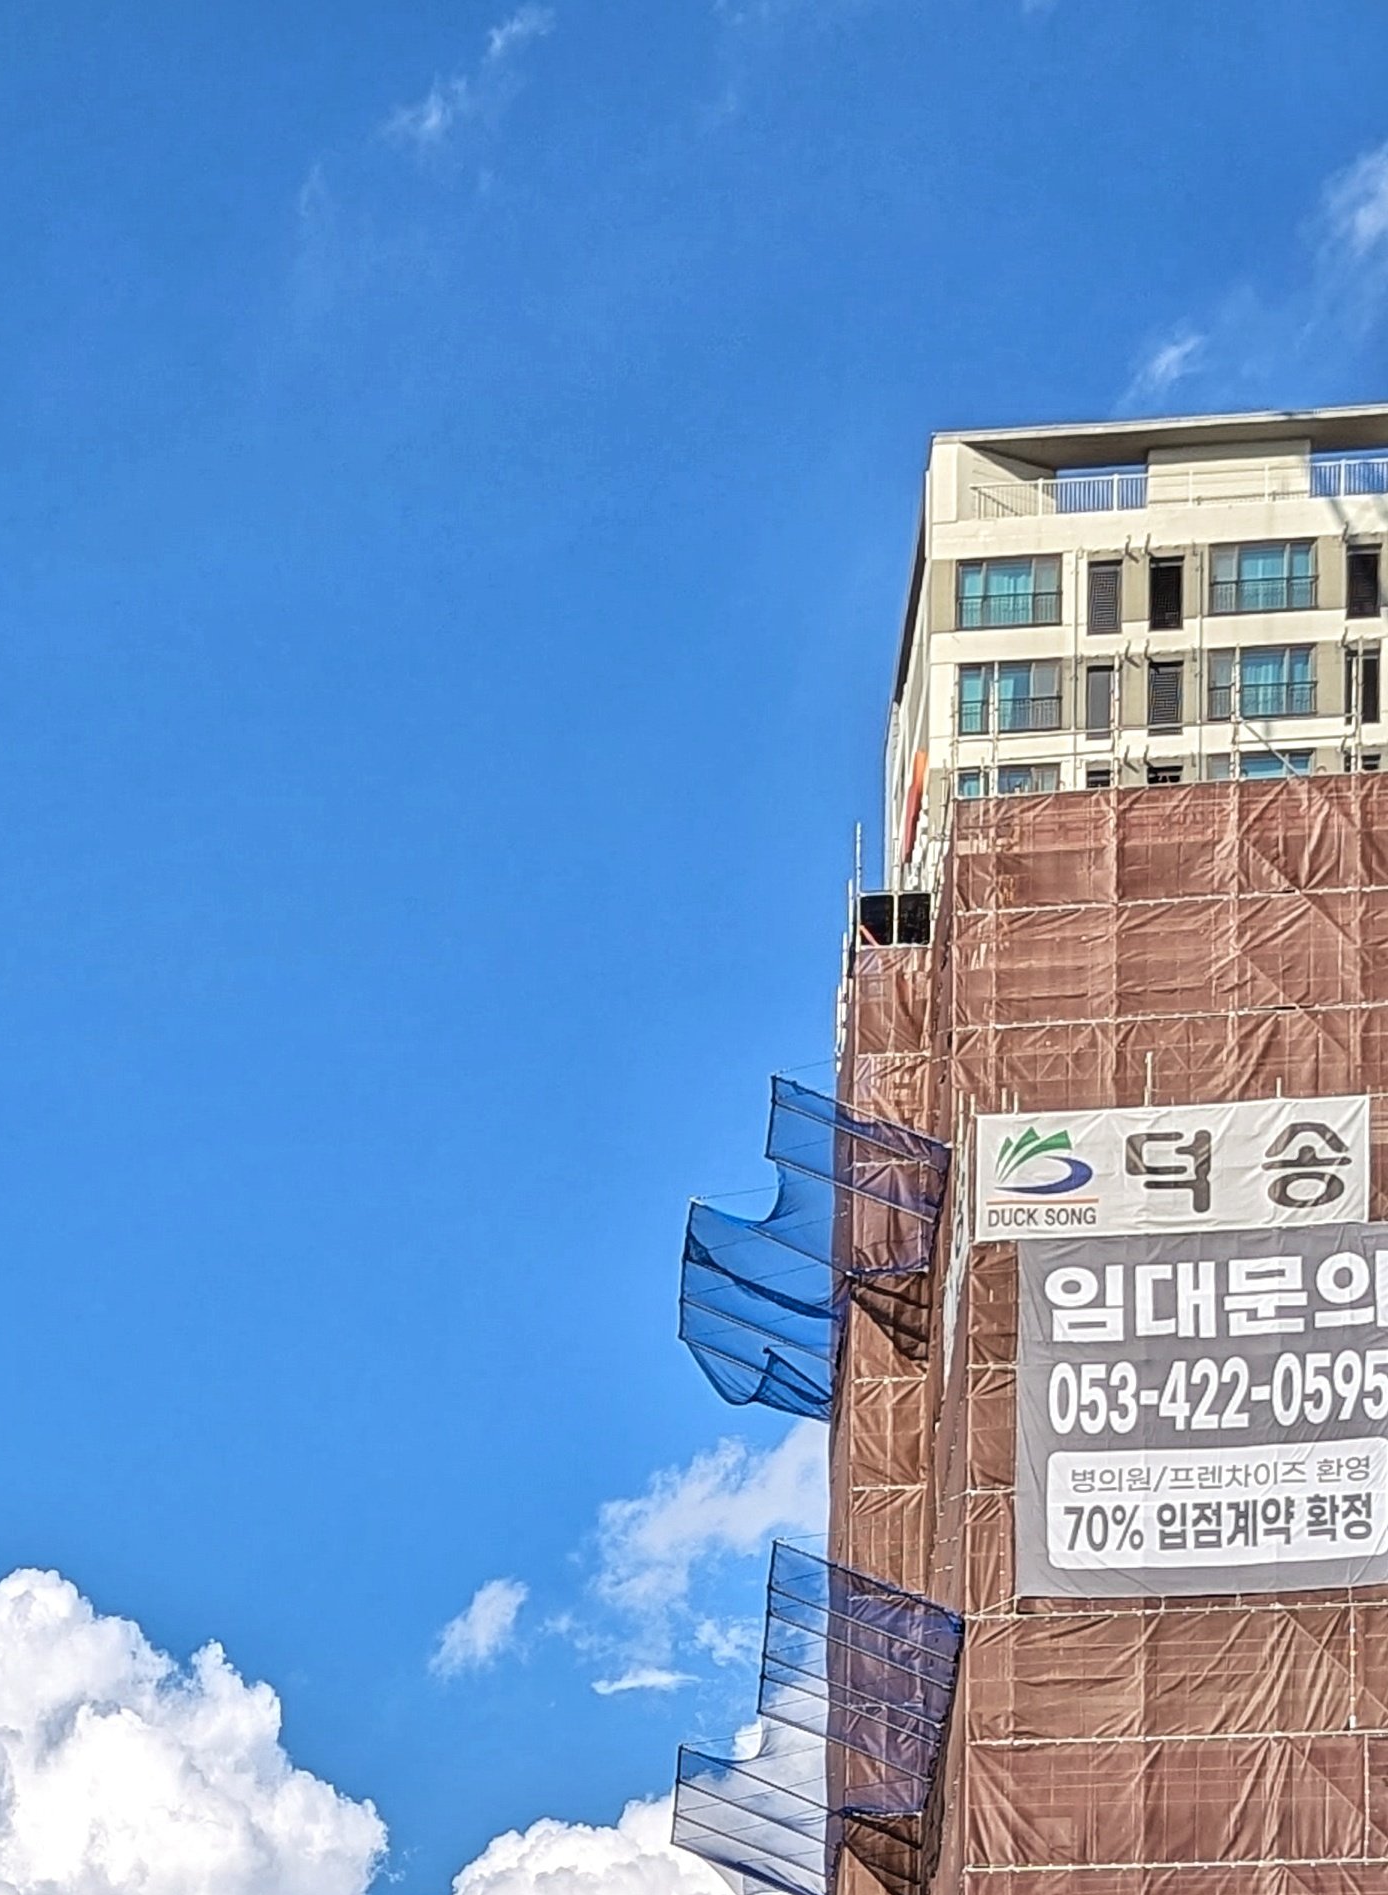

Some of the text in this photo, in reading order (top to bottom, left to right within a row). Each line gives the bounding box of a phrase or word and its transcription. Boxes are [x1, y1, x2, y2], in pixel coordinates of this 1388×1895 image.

[987, 1206, 1097, 1228] DUCK SONG
[1043, 1250, 1388, 1342] 임대문의
[1048, 1349, 1388, 1434] 053-422-0595
[1071, 1455, 1372, 1493] 병의원/프렌차이즈 환영
[1063, 1491, 1373, 1552] 70% 입점계약 확정
